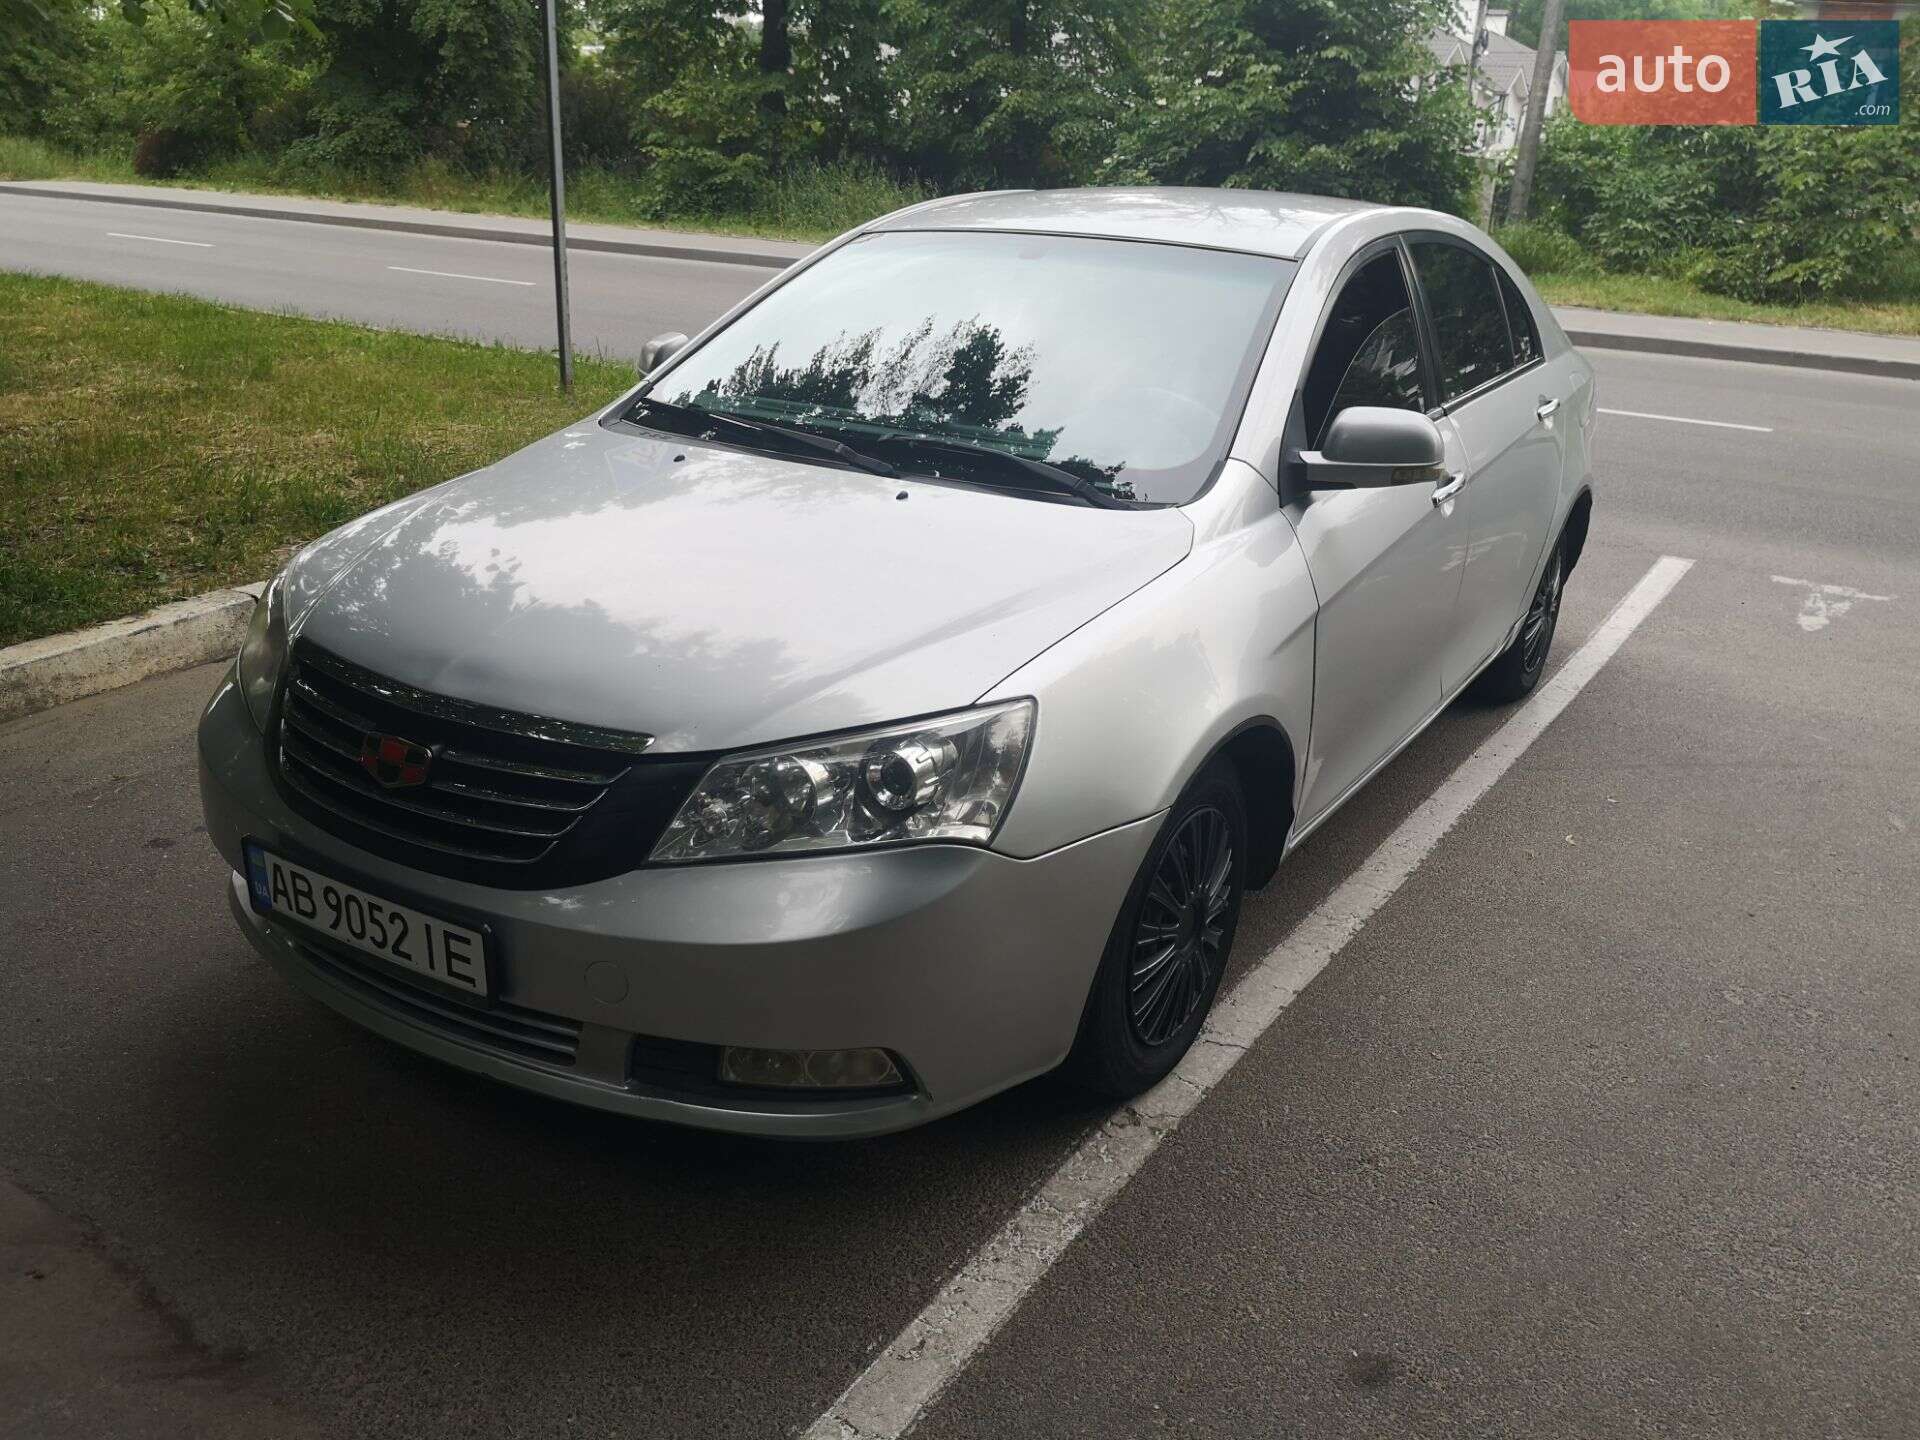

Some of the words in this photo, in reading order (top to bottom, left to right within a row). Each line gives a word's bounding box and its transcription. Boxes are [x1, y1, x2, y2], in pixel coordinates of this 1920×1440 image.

[272, 862, 317, 919] AB
[322, 886, 412, 962] 9052
[424, 923, 476, 987] IE
